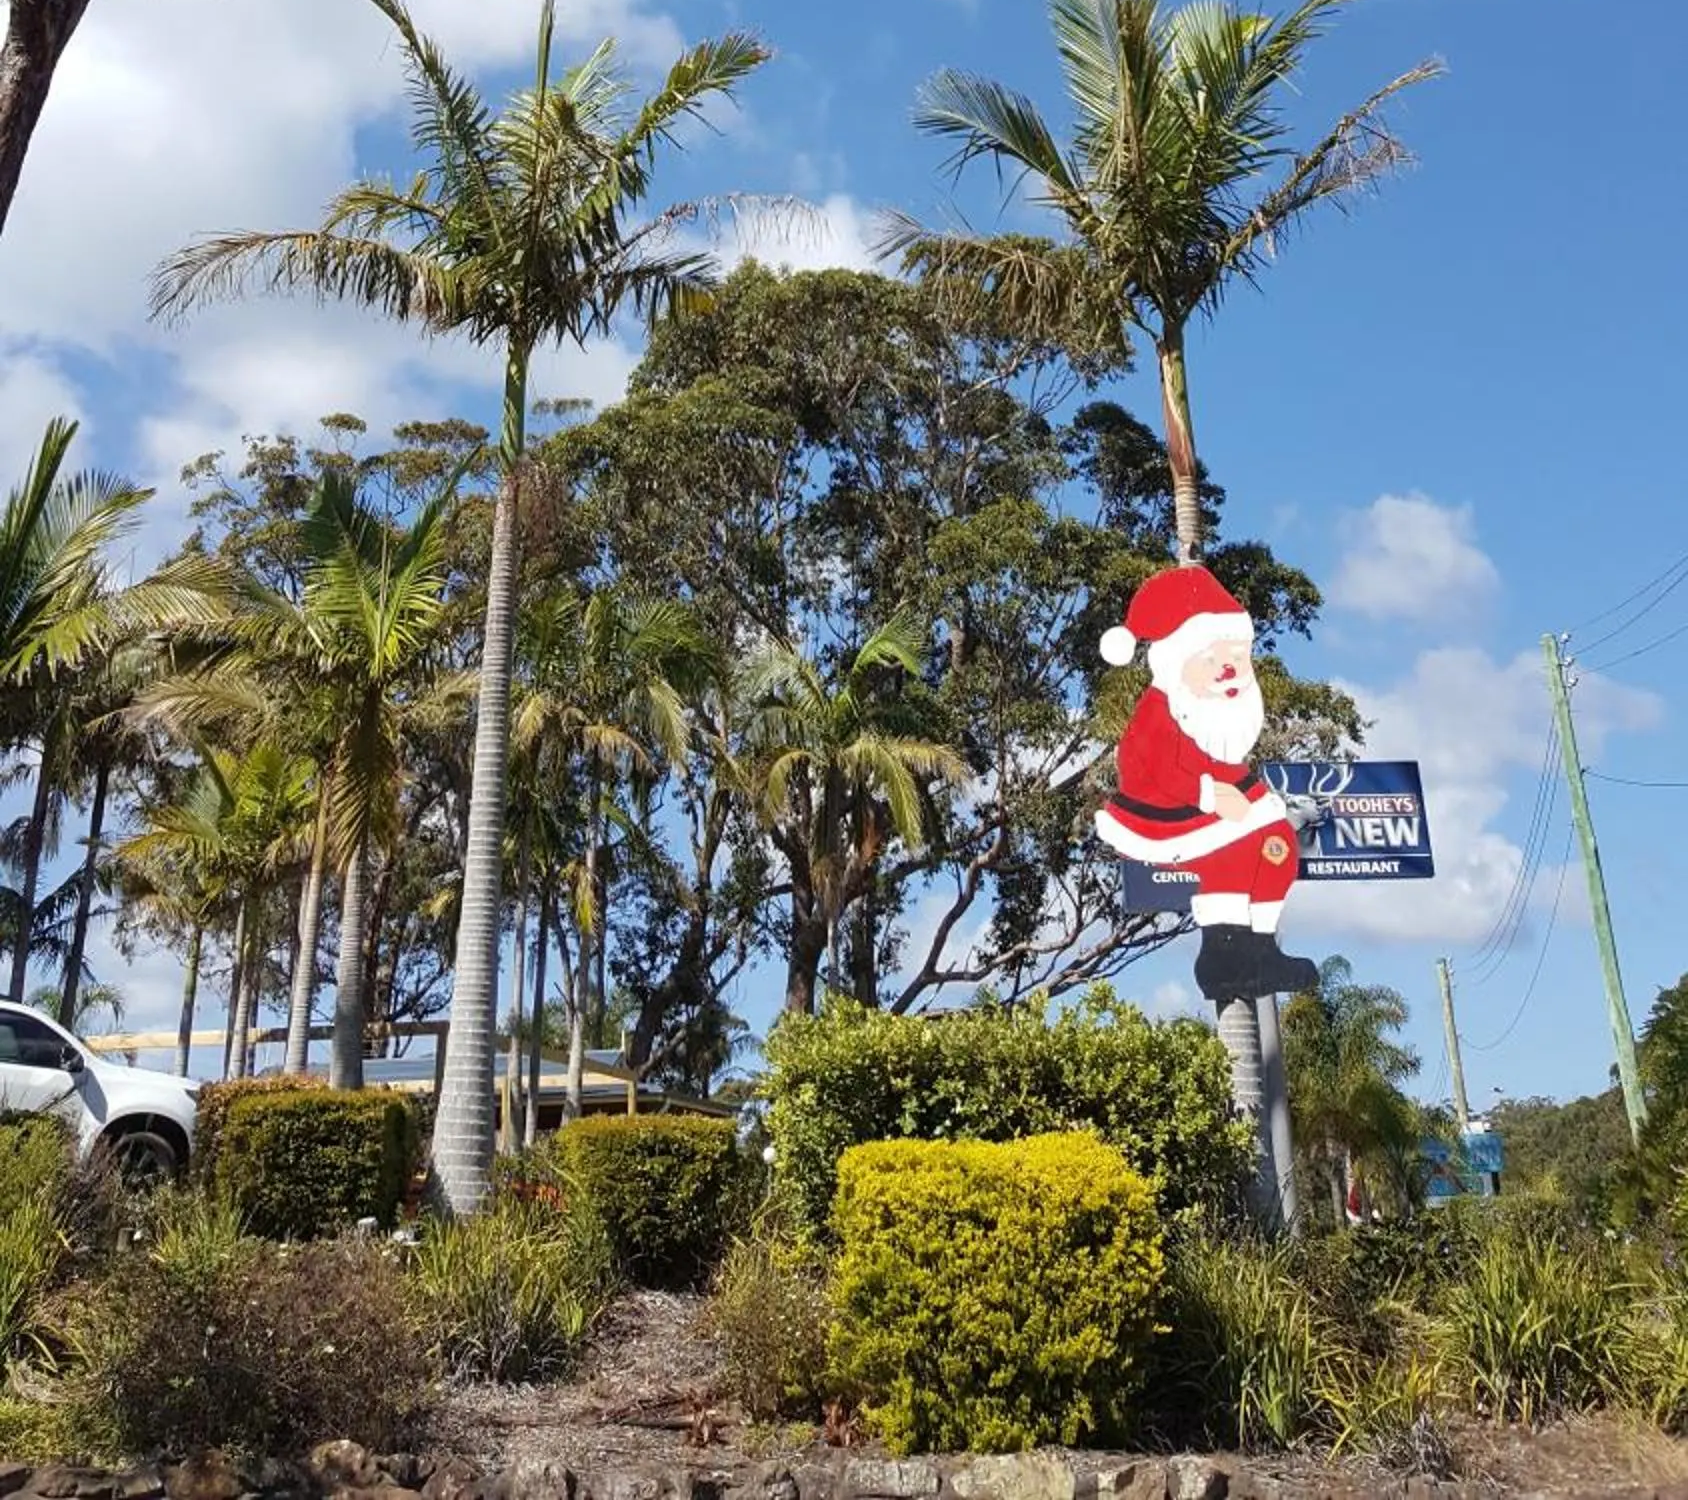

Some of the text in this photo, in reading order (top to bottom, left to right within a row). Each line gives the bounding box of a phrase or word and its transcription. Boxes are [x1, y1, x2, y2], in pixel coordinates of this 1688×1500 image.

[1336, 797, 1414, 813] TOOHEYS
[1334, 817, 1420, 849] NEW
[1307, 861, 1400, 875] RESTAURANT
